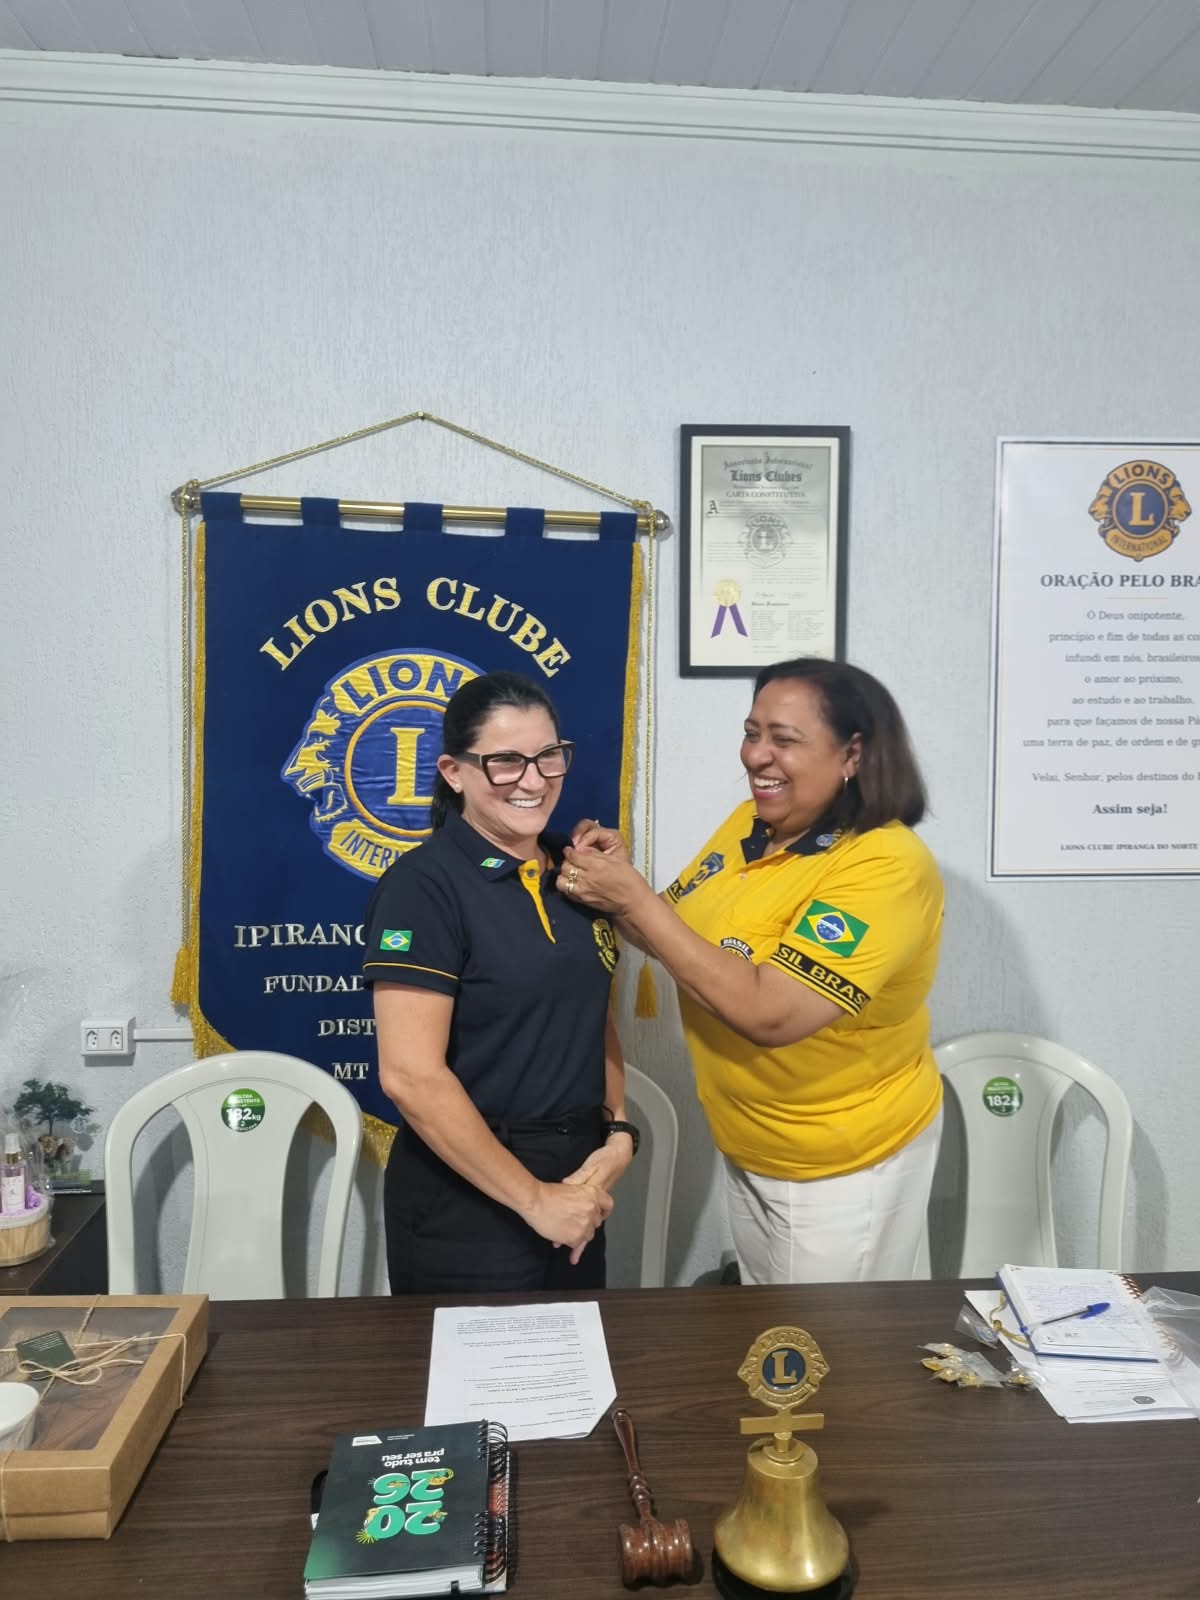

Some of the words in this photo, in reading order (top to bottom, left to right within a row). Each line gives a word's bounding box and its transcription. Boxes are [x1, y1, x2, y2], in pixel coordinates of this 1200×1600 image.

[730, 470, 762, 482] Lions
[765, 471, 802, 482] Clubes
[1113, 464, 1170, 486] LIONS
[1128, 492, 1155, 526] L
[1040, 572, 1113, 590] ORAÇÃO
[1119, 575, 1165, 587] PELO
[1099, 610, 1124, 620] Deus
[259, 577, 401, 671] LIONS
[426, 576, 572, 679] CLUBE
[1107, 632, 1124, 641] fim
[1127, 632, 1140, 641] de
[1142, 632, 1170, 641] todas
[340, 659, 464, 711] LION
[1087, 696, 1121, 704] estudo
[1047, 718, 1070, 728] para
[1073, 718, 1092, 727] que
[1096, 716, 1137, 727] façamos
[1140, 716, 1153, 725] de
[1023, 739, 1044, 747] uma
[1048, 738, 1073, 747] terra
[1076, 737, 1089, 746] de
[1115, 737, 1128, 746] de
[1131, 736, 1164, 746] ordem
[1176, 736, 1188, 746] de
[387, 727, 434, 806] L
[1064, 772, 1104, 783] Senhor,
[1107, 772, 1134, 783] pelos
[1136, 772, 1178, 781] destinos
[1182, 772, 1194, 781] do
[1093, 804, 1132, 814] Assim
[1136, 803, 1168, 816] seja!
[1060, 843, 1085, 851] LIONS
[1171, 842, 1199, 850] NORTE
[776, 947, 804, 969] SIL
[332, 1062, 369, 1080] MT
[772, 1351, 798, 1384] L
[424, 1448, 445, 1457] pra
[384, 1458, 413, 1469] tudo
[414, 1455, 441, 1465] tem
[366, 1500, 443, 1539] 20
